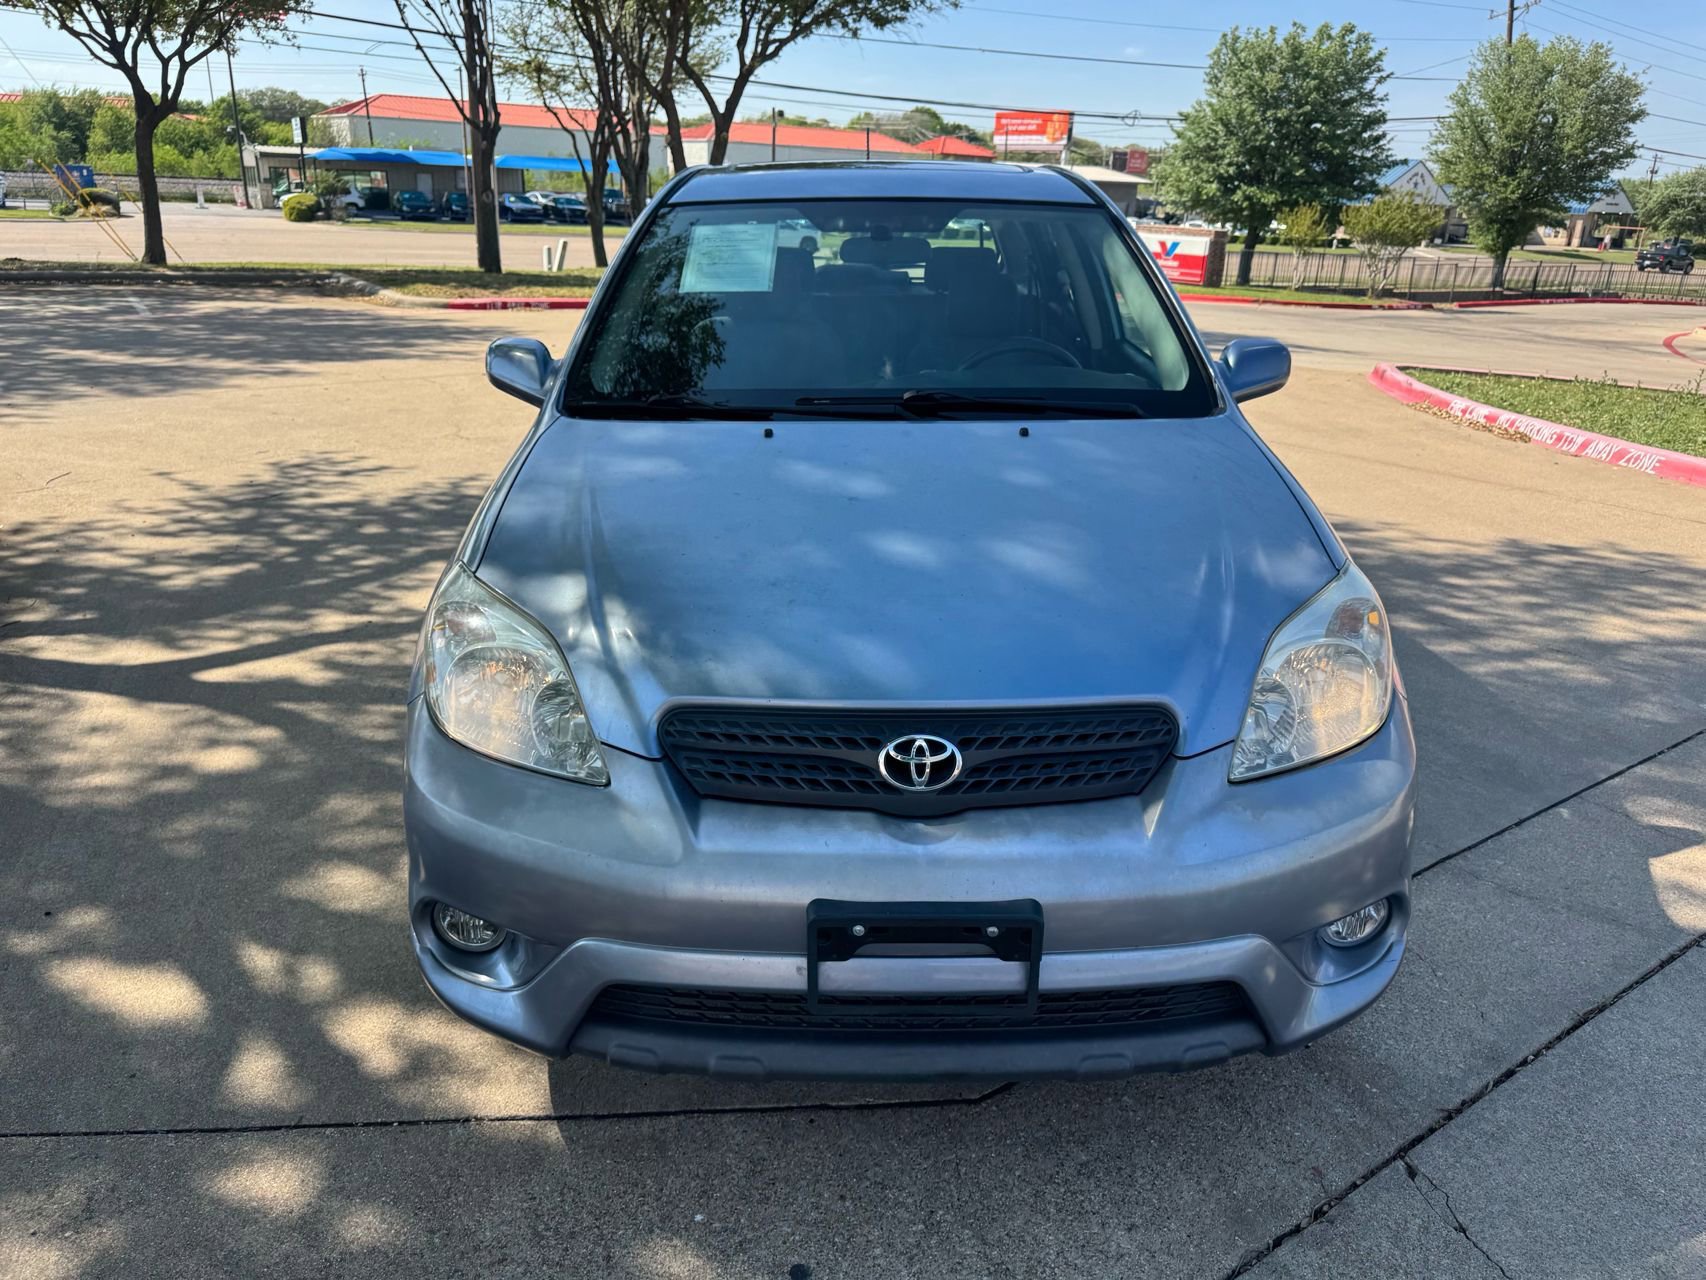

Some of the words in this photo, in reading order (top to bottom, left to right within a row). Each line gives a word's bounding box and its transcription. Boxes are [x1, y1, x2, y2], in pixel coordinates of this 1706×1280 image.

[1497, 413, 1515, 427] NO
[1513, 417, 1557, 444] PARKING
[1556, 431, 1585, 452] TOW
[1582, 440, 1622, 462] AWAY
[1618, 447, 1666, 474] ZONE
